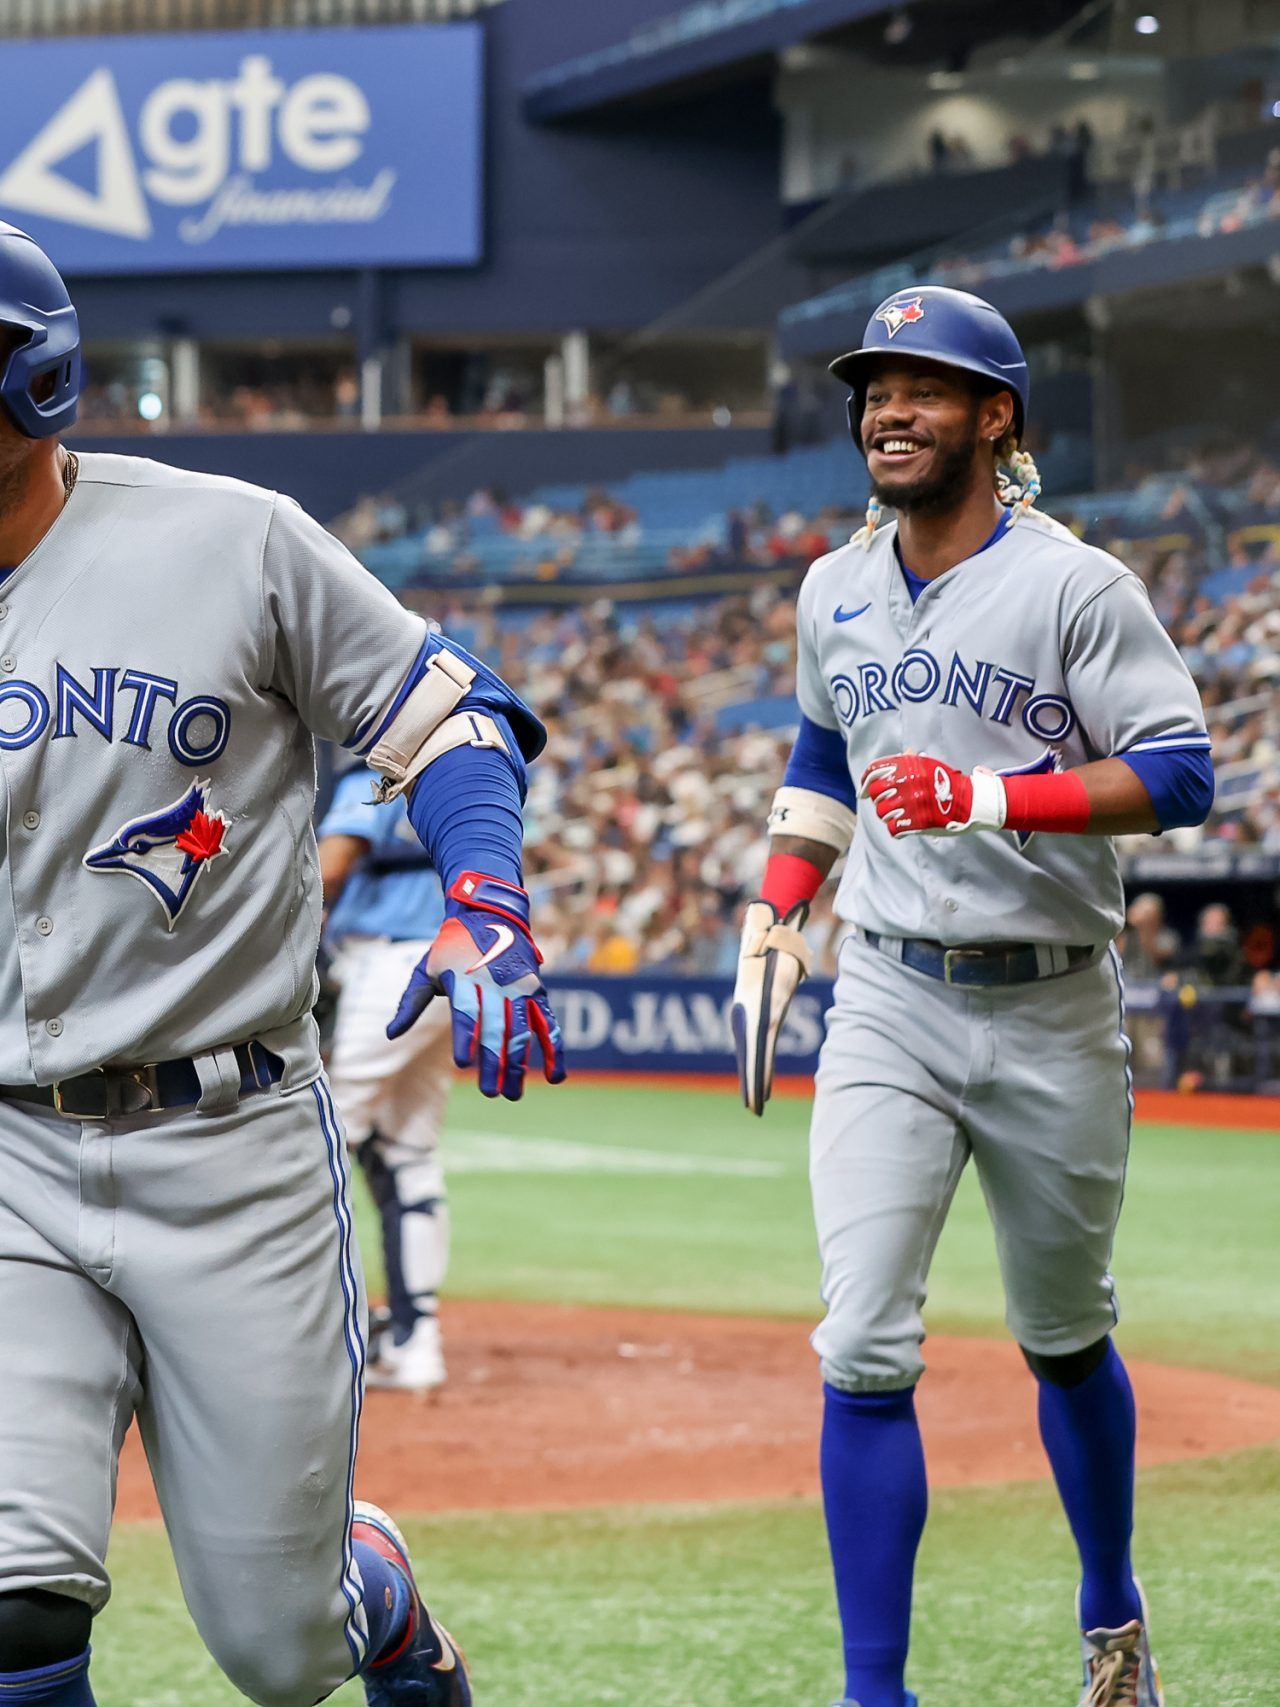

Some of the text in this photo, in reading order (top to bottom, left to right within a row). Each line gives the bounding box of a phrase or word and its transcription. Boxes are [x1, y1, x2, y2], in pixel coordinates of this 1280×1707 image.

[138, 54, 372, 206] gte
[178, 166, 398, 245] financial
[831, 648, 1076, 743] ORONTO
[612, 991, 824, 1057] JAMS
